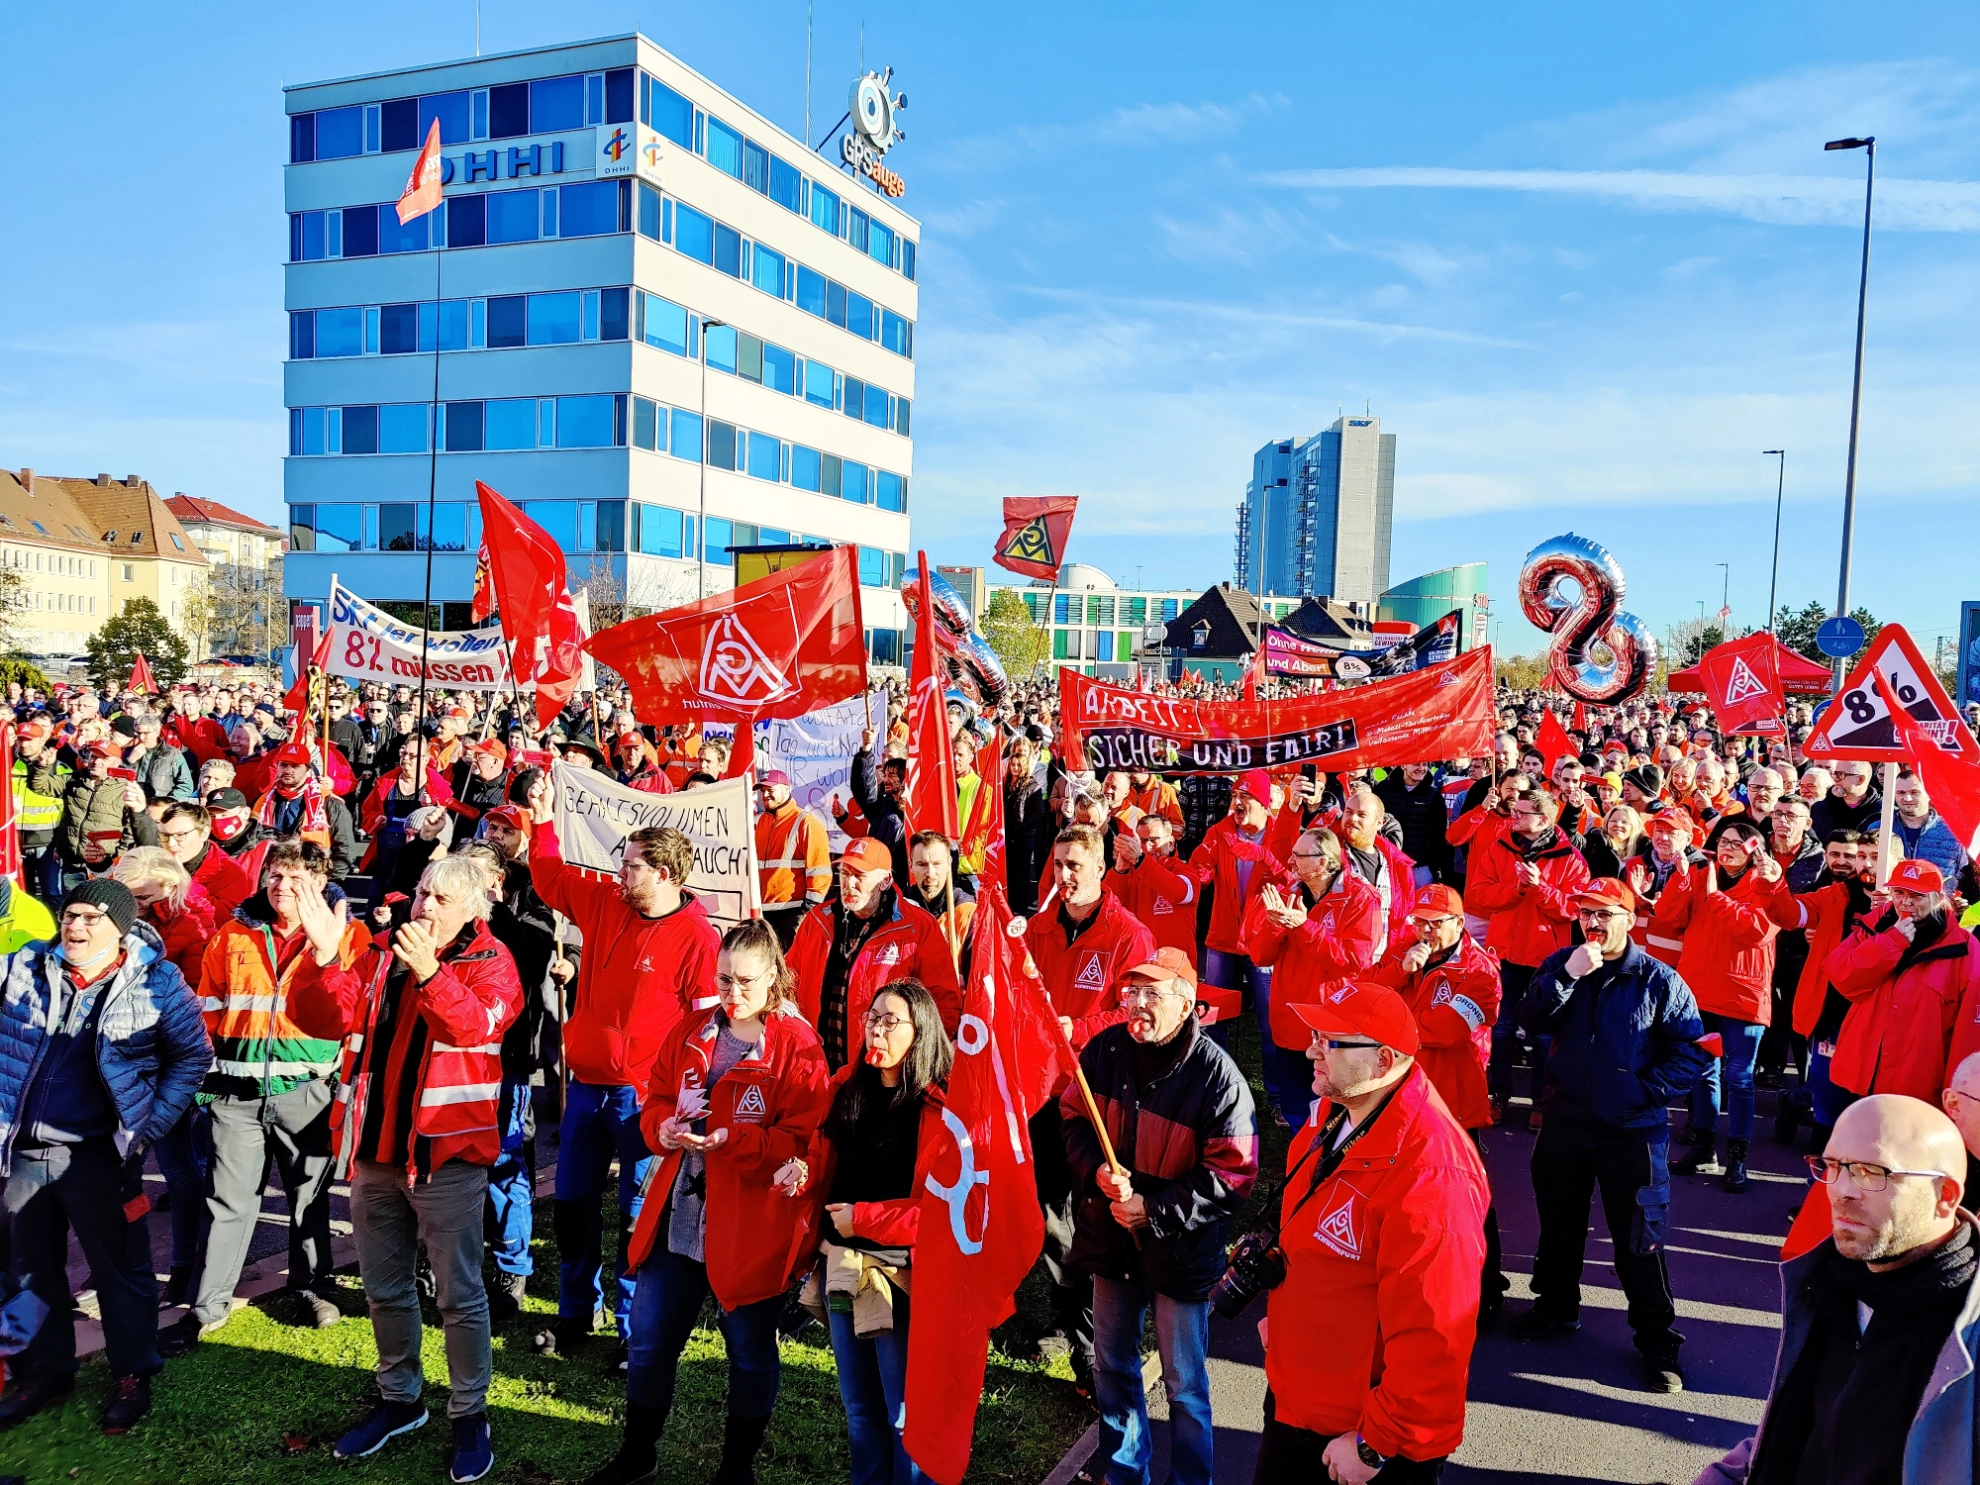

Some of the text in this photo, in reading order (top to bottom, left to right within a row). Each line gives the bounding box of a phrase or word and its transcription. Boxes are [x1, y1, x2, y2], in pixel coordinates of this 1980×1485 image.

[604, 165, 630, 174] DHHI
[1348, 419, 1373, 428] SKF
[426, 633, 500, 653] wollen
[1268, 635, 1297, 650] Ohne
[391, 655, 495, 682] müssen
[1267, 657, 1328, 672] und Aber!
[1343, 661, 1361, 670] 8%
[1843, 671, 1917, 724] 8%
[774, 722, 799, 757] Tag
[1088, 725, 1346, 768] SICHER UND FAIR!
[1368, 732, 1410, 746] Umfassende
[1455, 996, 1484, 1025] ORDNER
[1312, 1231, 1361, 1261] SCHWEINFURT
